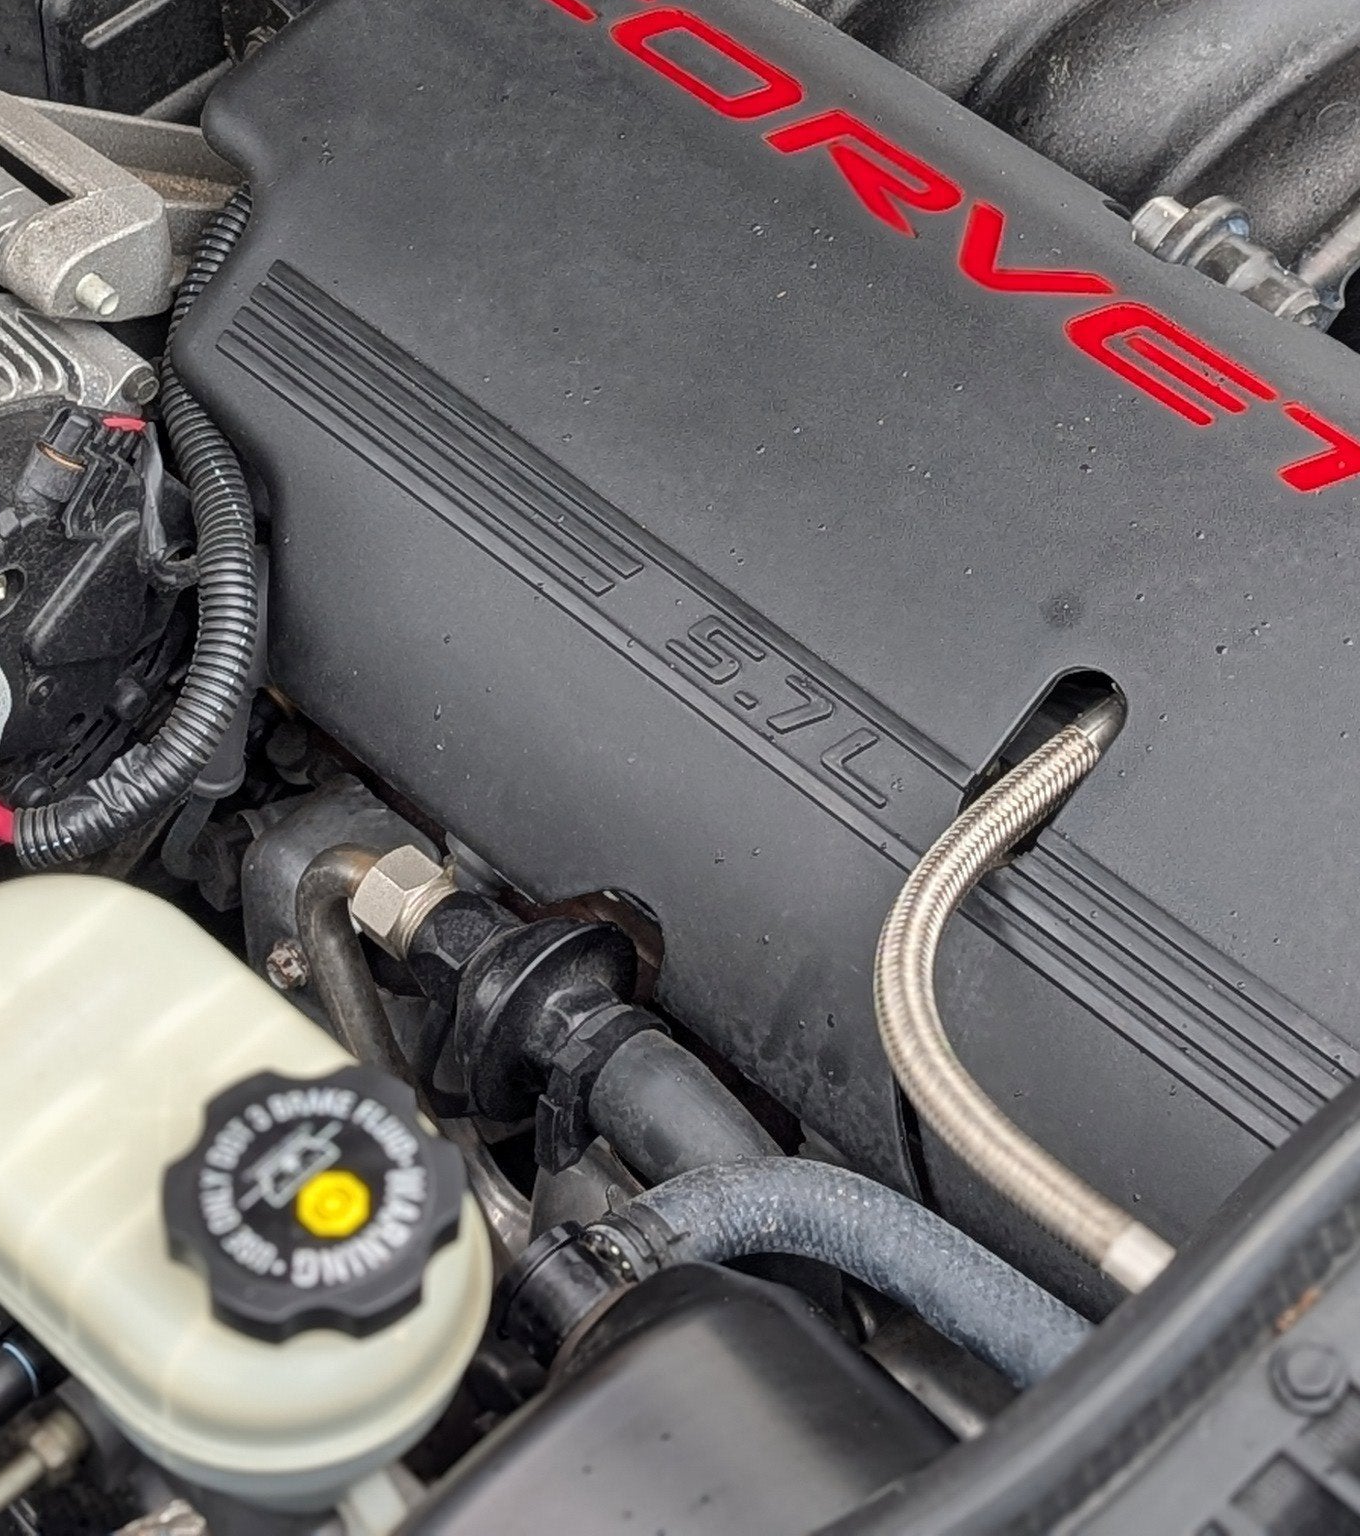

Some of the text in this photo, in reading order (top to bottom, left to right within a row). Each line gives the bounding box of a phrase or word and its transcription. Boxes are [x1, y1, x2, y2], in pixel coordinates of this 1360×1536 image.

[664, 614, 888, 810] 5.7L
[244, 1103, 273, 1133] 3
[266, 1086, 359, 1124] BRAKE
[350, 1098, 420, 1161] FLUID
[199, 1167, 243, 1237] ONLY
[290, 1166, 428, 1290] WARNING
[220, 1227, 279, 1277] USE
